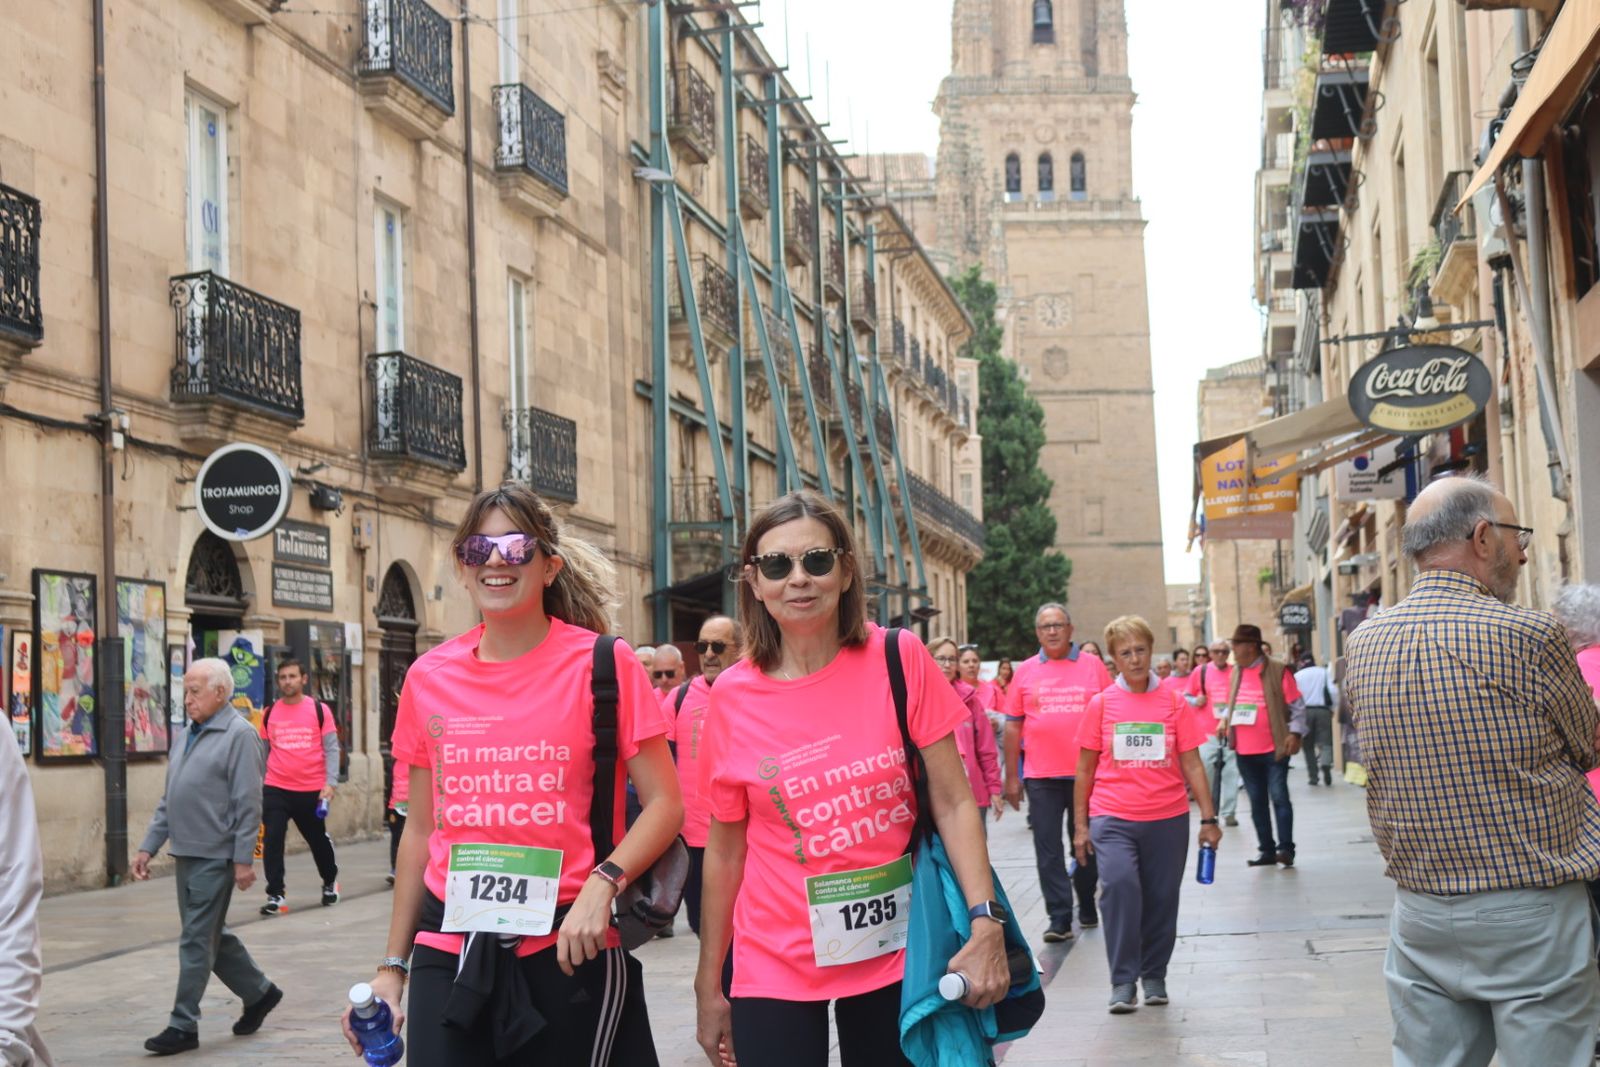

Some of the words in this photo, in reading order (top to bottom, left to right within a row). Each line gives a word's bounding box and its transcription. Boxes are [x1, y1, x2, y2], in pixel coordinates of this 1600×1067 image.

[1365, 356, 1471, 399] Coca-Cola
[1409, 419, 1440, 427] PARIS
[202, 484, 280, 498] TROTAMUNDOS
[229, 504, 254, 515] Shop
[443, 743, 469, 764] En
[475, 740, 570, 762] marcha
[1126, 735, 1153, 747] 8675
[445, 768, 534, 794] contra
[538, 767, 564, 792] el
[783, 774, 820, 800] En
[824, 746, 906, 786] marcha
[445, 795, 567, 827] cáncer
[796, 782, 893, 828] contra
[893, 769, 912, 796] el
[768, 786, 807, 864] SALAMANCA
[457, 848, 489, 856] Salamanca
[470, 874, 528, 904] 1234
[814, 878, 852, 888] Salamanca
[853, 875, 862, 883] en
[862, 871, 888, 881] marcha
[815, 887, 837, 895] contra
[846, 882, 870, 891] cáncer
[838, 894, 897, 931] 1235
